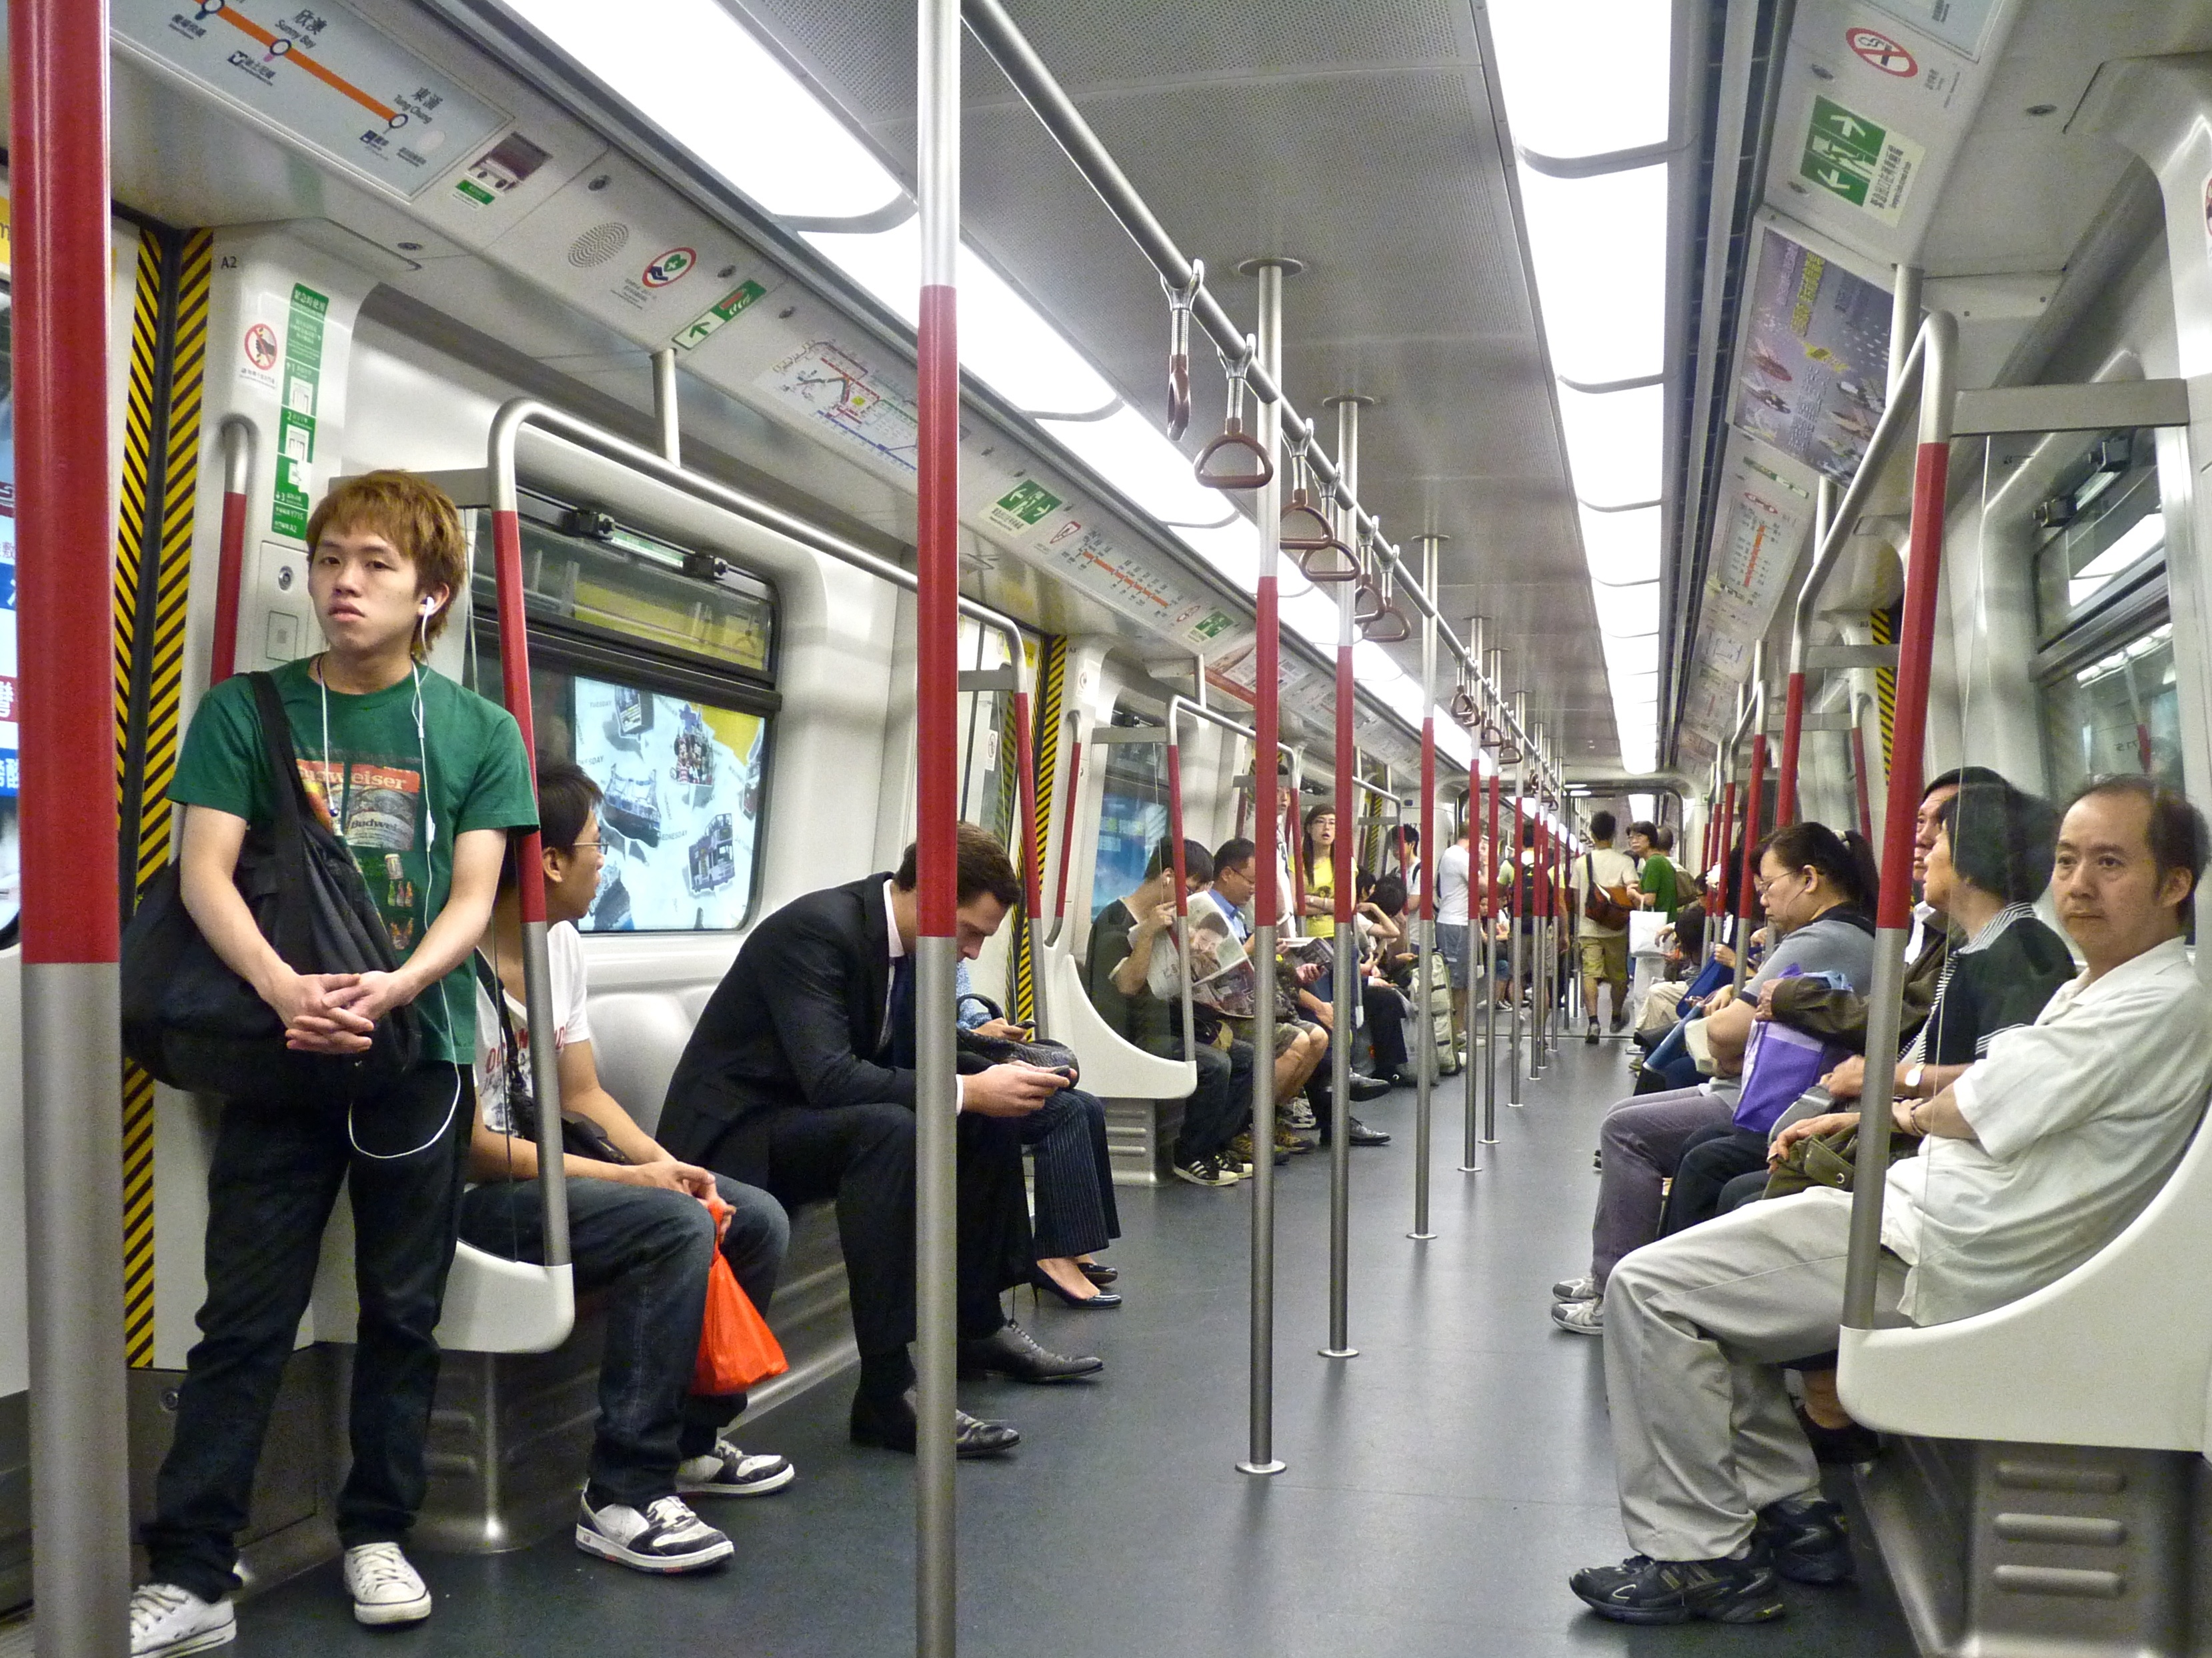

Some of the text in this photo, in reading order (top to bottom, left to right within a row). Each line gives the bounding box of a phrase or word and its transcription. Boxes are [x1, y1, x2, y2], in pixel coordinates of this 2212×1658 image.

[275, 19, 317, 49] Sunny Bay
[393, 94, 433, 125] Tung Chung
[220, 256, 237, 270] A2
